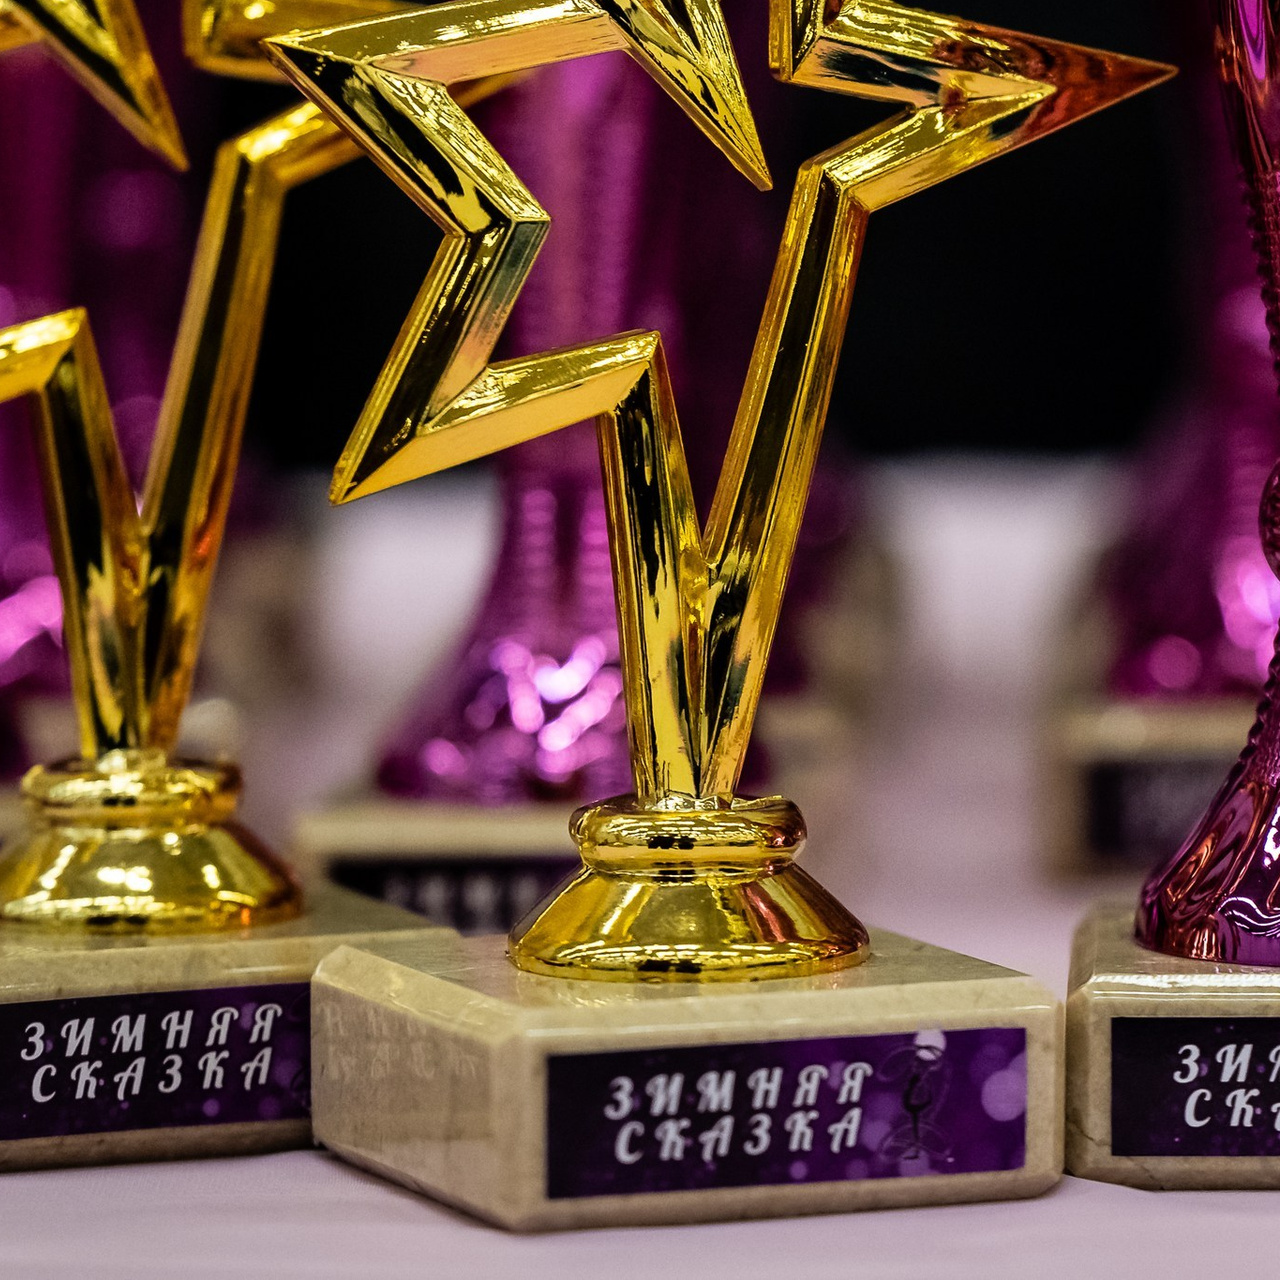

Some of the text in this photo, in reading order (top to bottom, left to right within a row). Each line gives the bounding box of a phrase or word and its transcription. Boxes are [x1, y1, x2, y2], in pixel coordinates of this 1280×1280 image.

[21, 1004, 283, 1061] ЗИМНЯЯ
[31, 1048, 273, 1103] СКАЗКА
[605, 1063, 873, 1120] ЗИМНЯЯ
[615, 1108, 863, 1165] СКАЗКА
